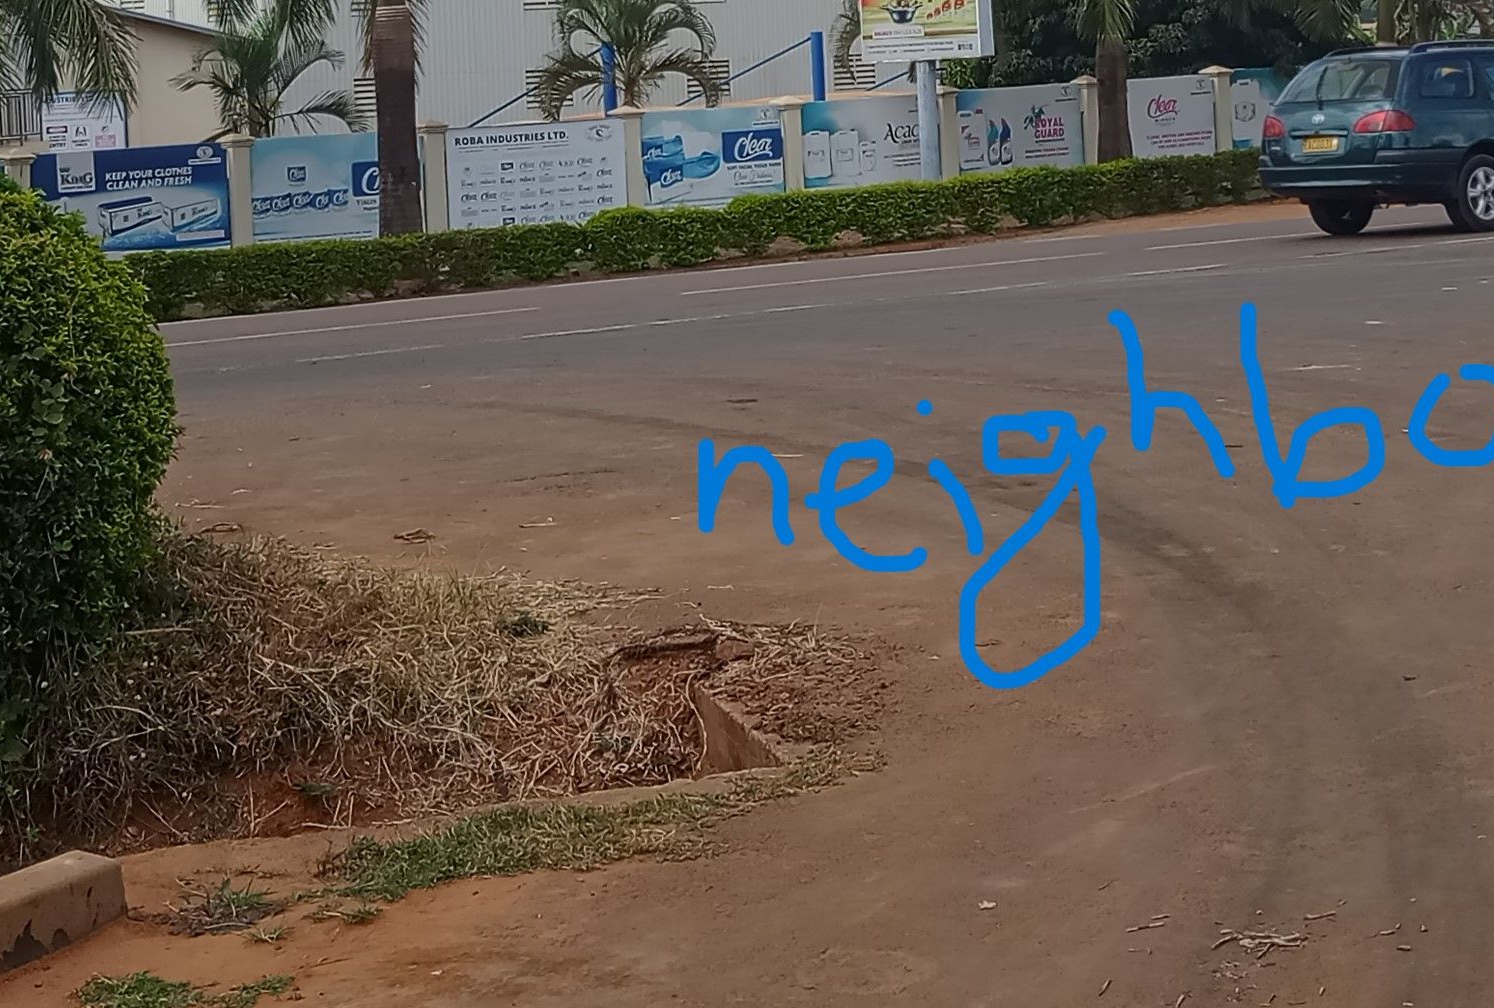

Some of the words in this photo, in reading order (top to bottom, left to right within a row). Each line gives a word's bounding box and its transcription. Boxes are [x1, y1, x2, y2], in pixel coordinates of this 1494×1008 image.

[1147, 94, 1178, 118] Clear
[1034, 117, 1065, 129] ROYAL
[454, 136, 485, 147] ROBA
[486, 131, 546, 144] INDUSTRIES
[547, 130, 570, 141] LTD.
[883, 122, 920, 144] Acac
[1034, 127, 1065, 139] GUARD
[734, 132, 773, 161] Clear
[105, 171, 127, 182] KEEP
[127, 170, 153, 180] YOUR
[154, 166, 193, 178] CLOTHES
[106, 180, 139, 191] CLEAN
[139, 178, 162, 189] AND
[163, 175, 193, 187] FRESH
